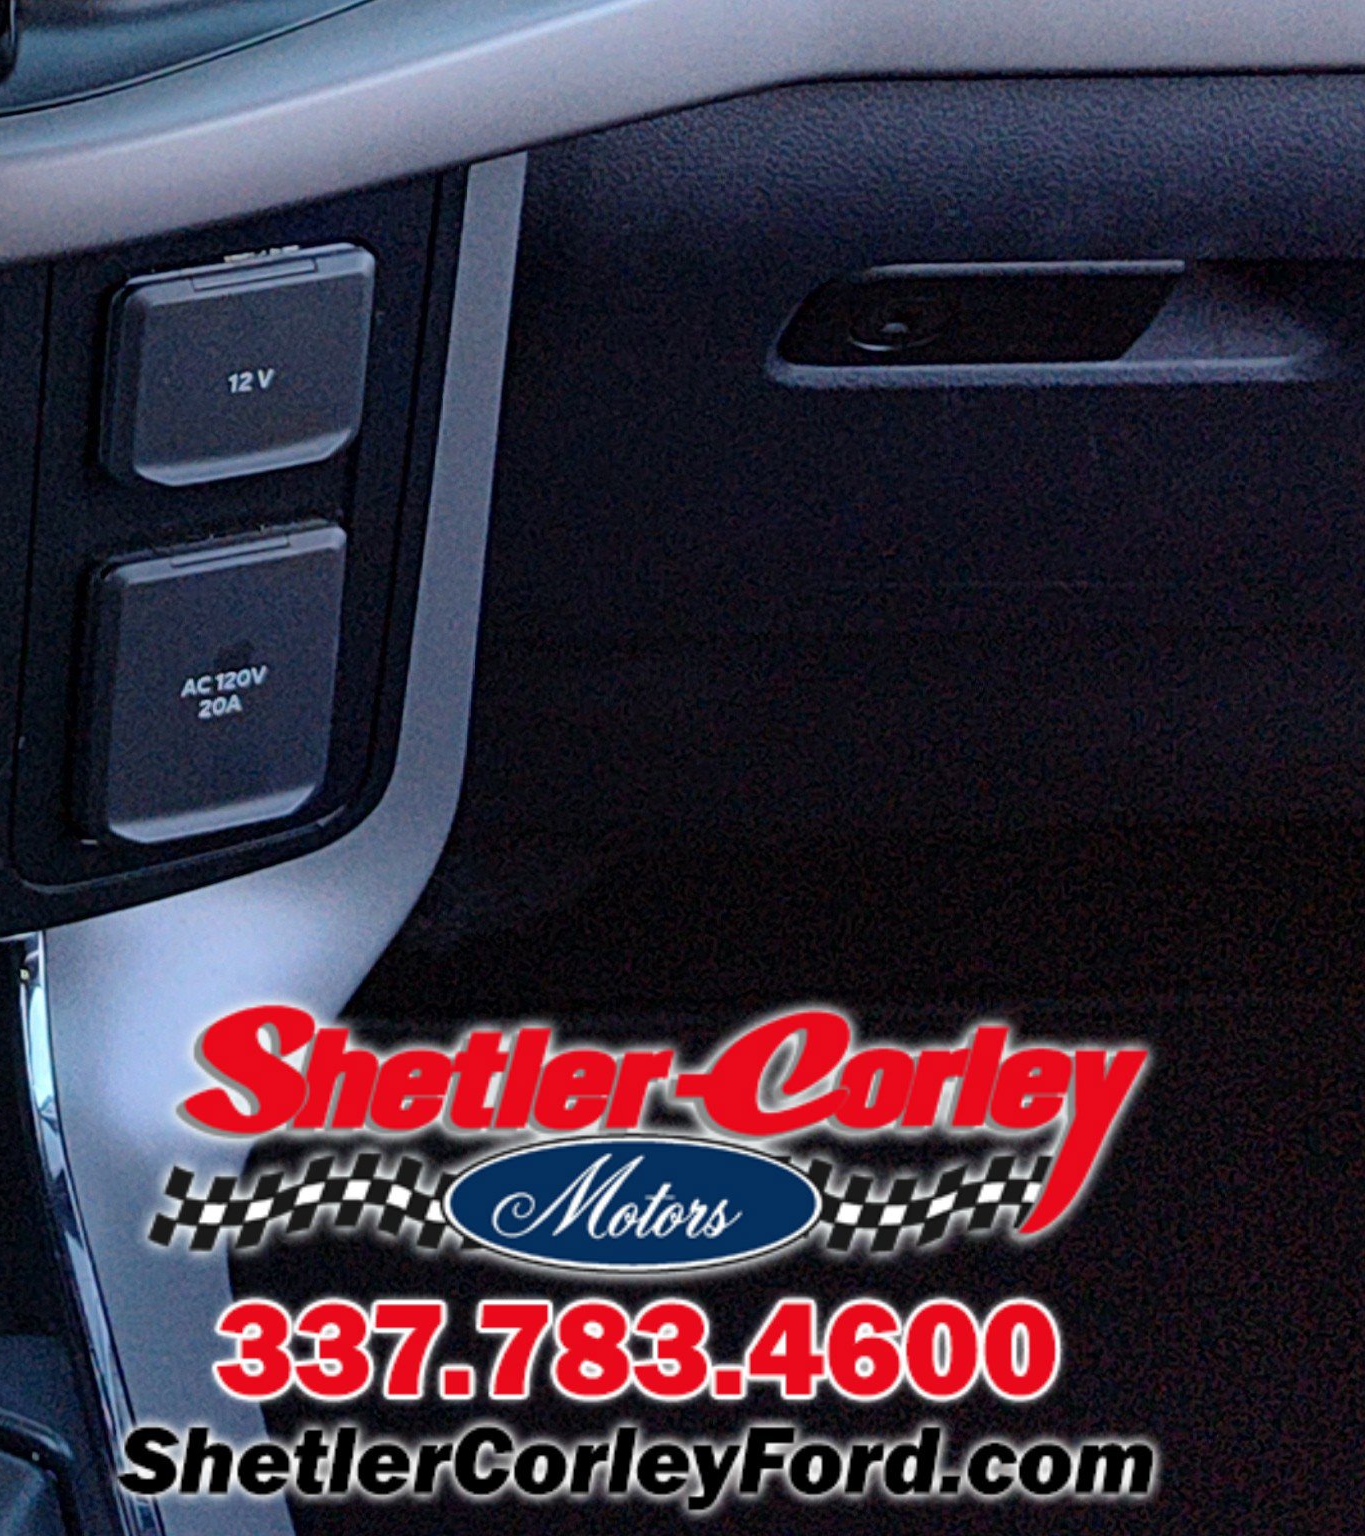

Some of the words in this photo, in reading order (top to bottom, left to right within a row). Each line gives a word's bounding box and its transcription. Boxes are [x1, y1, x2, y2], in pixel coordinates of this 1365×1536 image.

[228, 371, 253, 394] 12
[257, 368, 275, 390] V
[180, 674, 213, 698] AC
[215, 665, 269, 693] 120V
[197, 698, 243, 720] 20A
